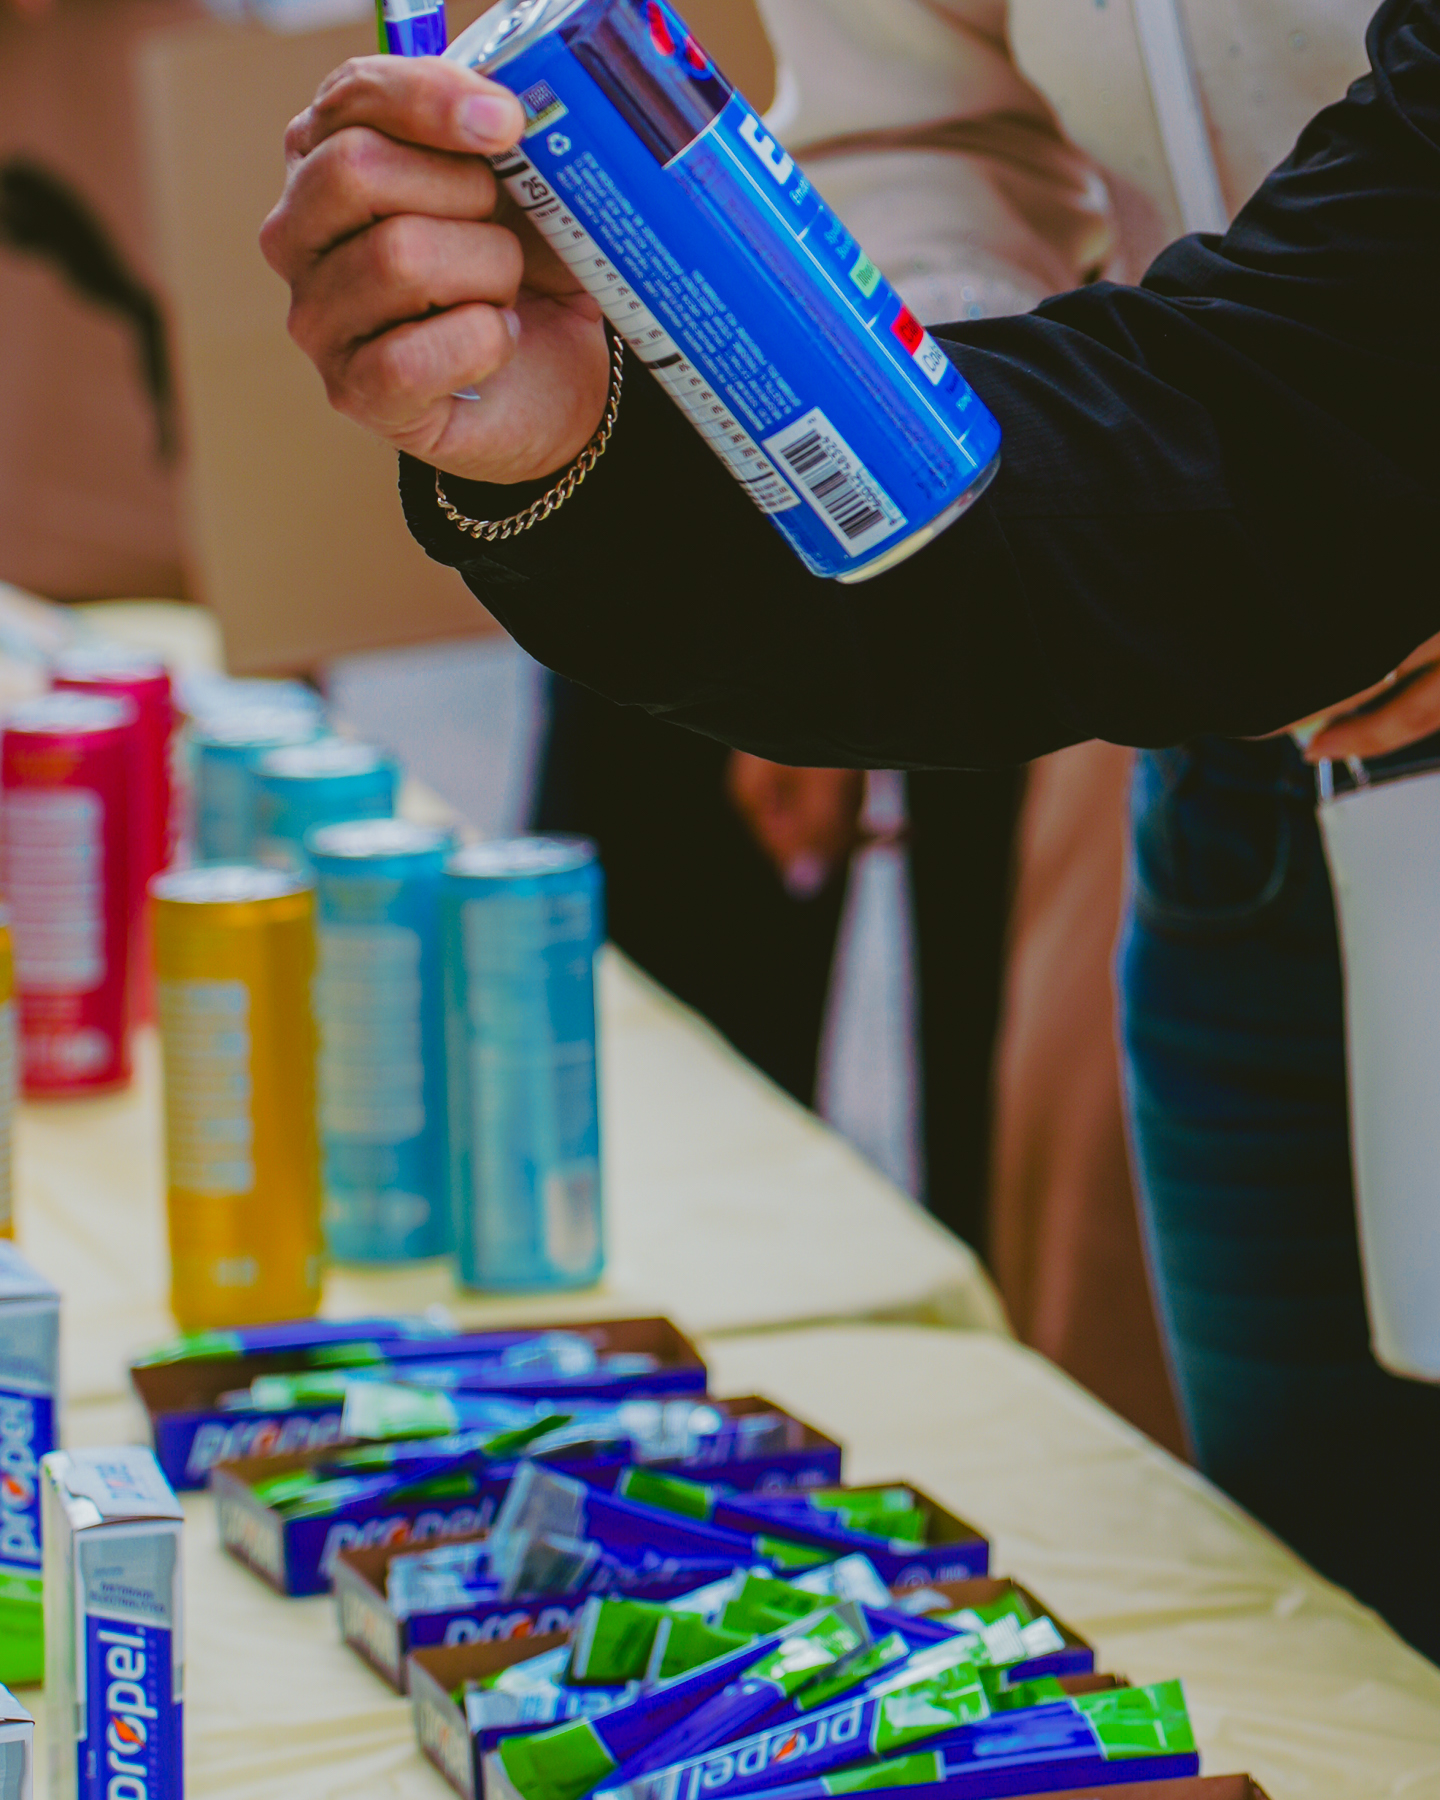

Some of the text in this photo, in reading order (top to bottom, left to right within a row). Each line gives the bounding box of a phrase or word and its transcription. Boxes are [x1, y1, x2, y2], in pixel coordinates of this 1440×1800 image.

[520, 174, 549, 200] 25
[98, 1628, 158, 1800] propel
[684, 1703, 866, 1800] propel
